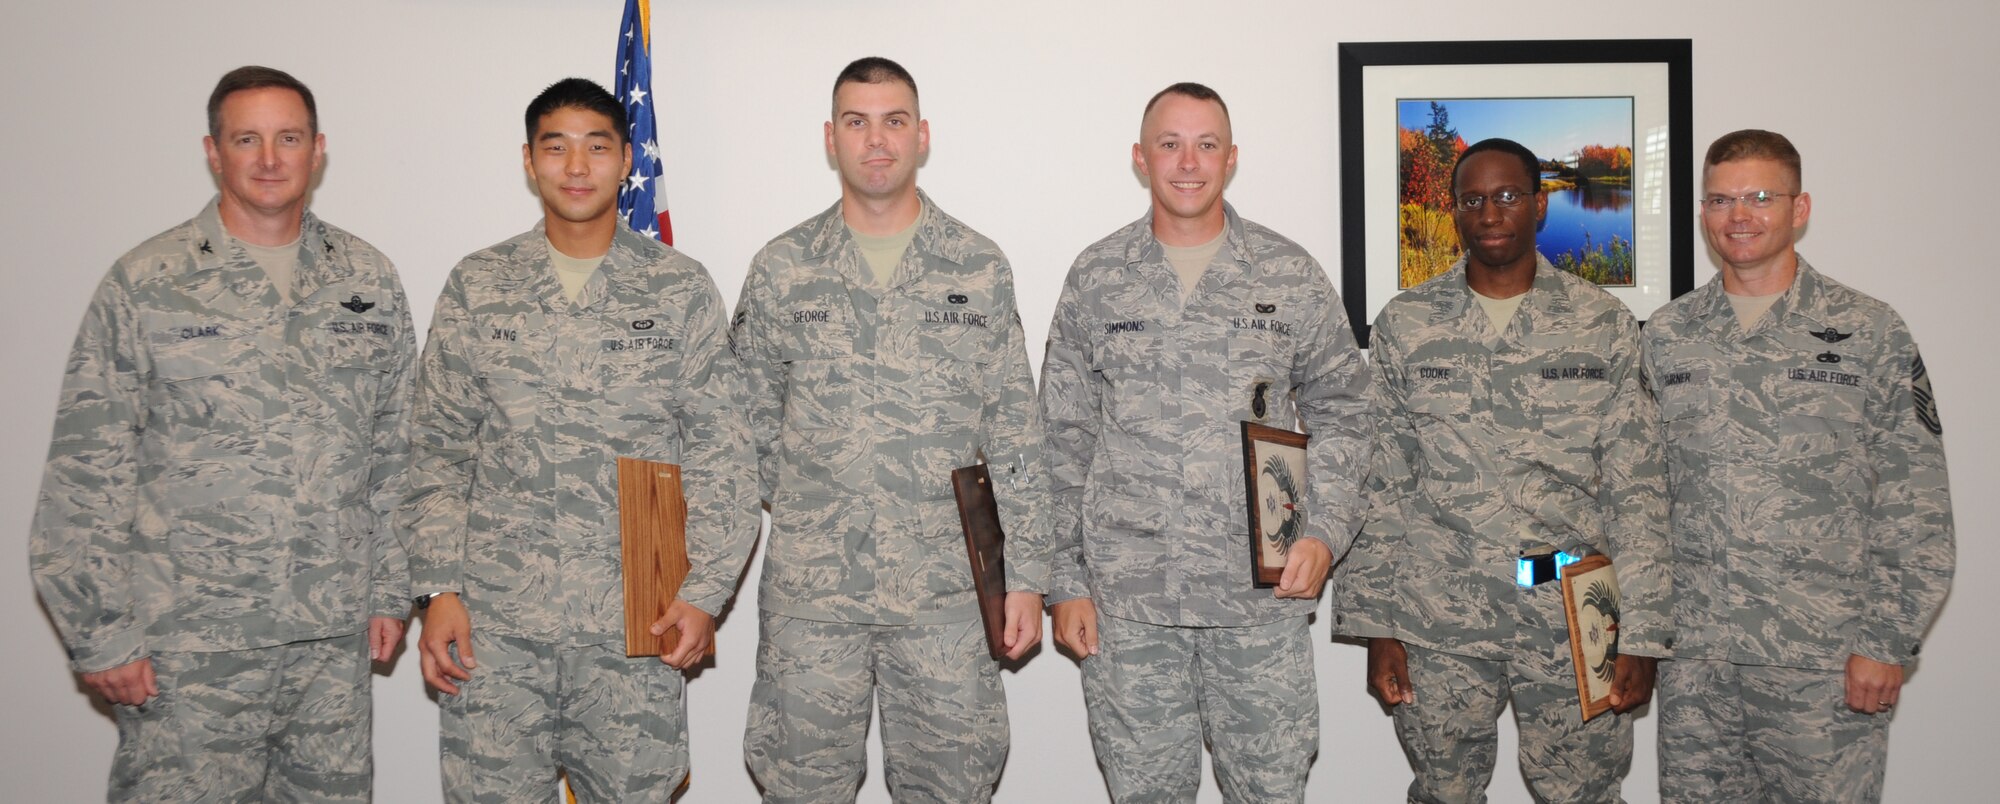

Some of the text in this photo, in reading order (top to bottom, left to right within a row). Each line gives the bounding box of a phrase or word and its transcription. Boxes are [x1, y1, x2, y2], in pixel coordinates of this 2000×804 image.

[793, 310, 830, 323] GEORGE
[925, 311, 988, 328] U.S. AIR FORCE
[181, 325, 219, 339] CLARK
[1104, 320, 1145, 335] SIMMONS
[1233, 317, 1291, 336] U.S. AIR FORCE
[492, 328, 516, 341] JANG
[628, 338, 645, 350] AIR
[646, 337, 674, 350] FORCE
[1420, 367, 1450, 380] COOKE
[1541, 367, 1605, 380] U.S. AIR FORCE
[1808, 369, 1828, 382] AIR
[1829, 371, 1862, 387] FORCE
